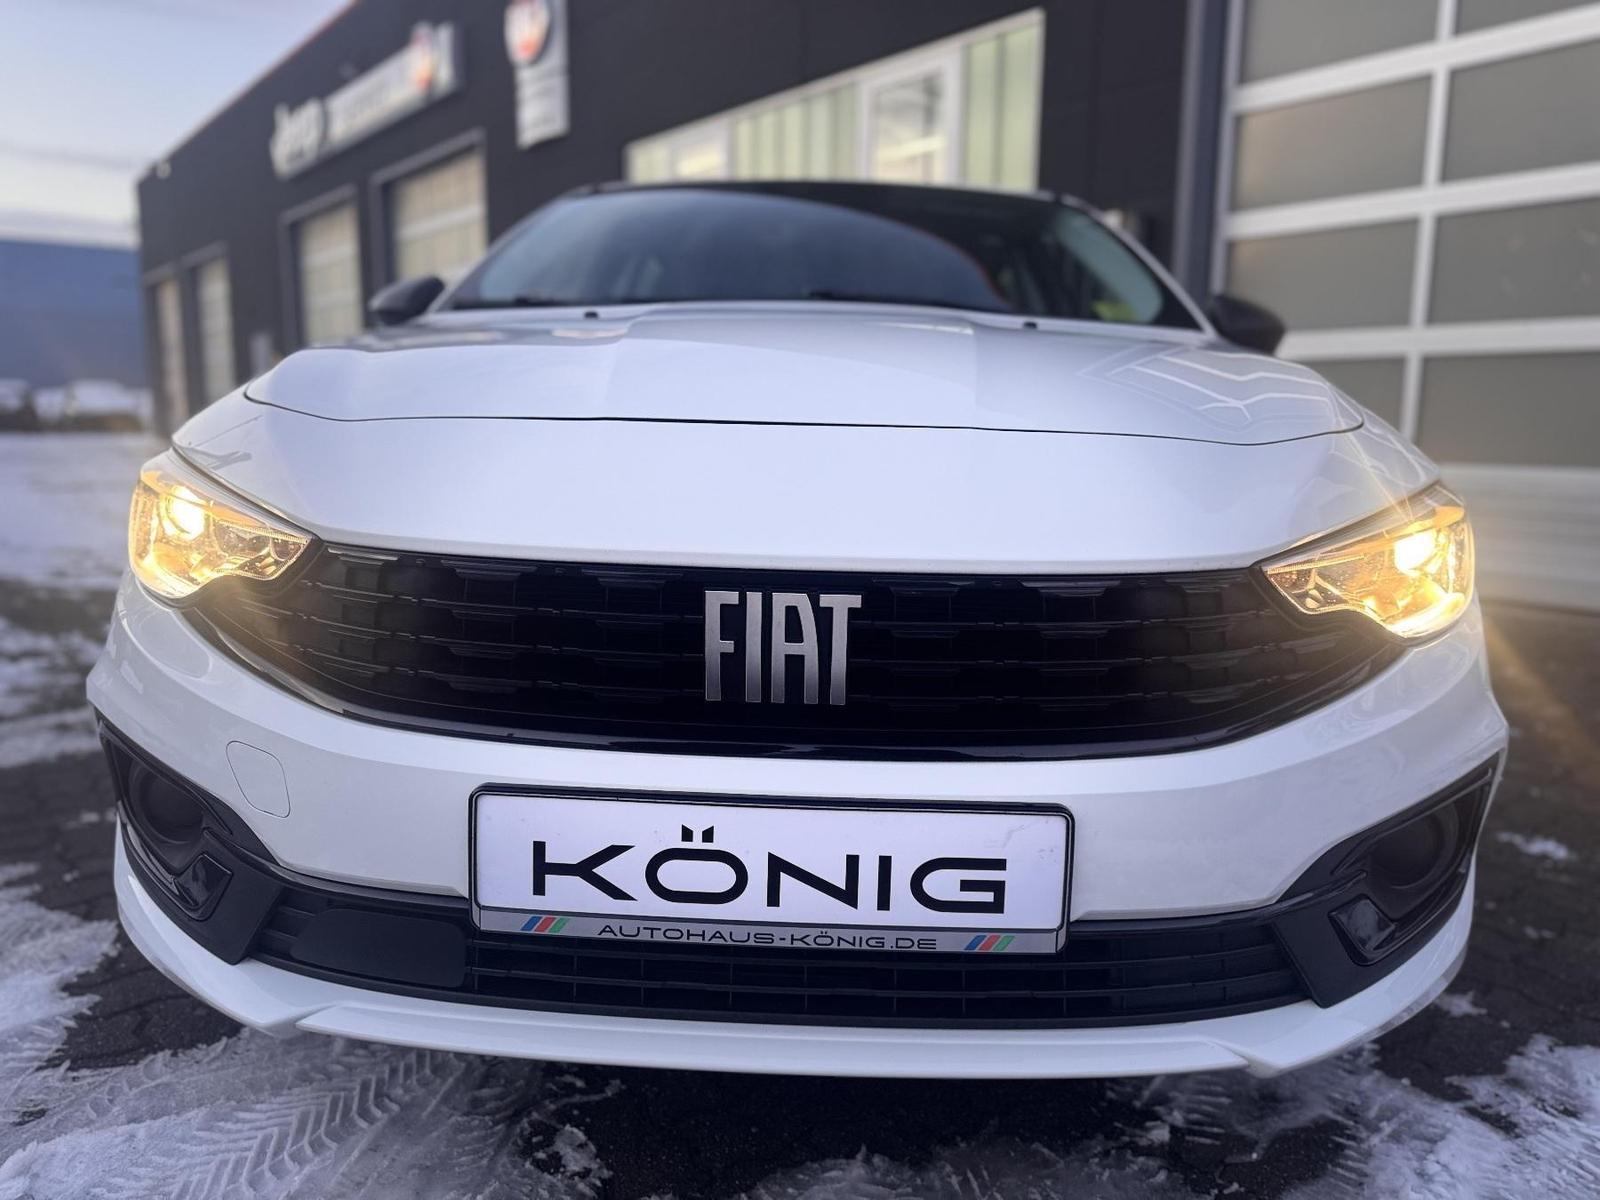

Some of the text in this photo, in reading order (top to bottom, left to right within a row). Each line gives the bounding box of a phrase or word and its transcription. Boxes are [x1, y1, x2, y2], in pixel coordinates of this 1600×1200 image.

[704, 590, 862, 705] FIAT
[532, 825, 1007, 914] KÖNIG
[597, 924, 937, 951] AUTOHAUS-KÖNIG.DE
